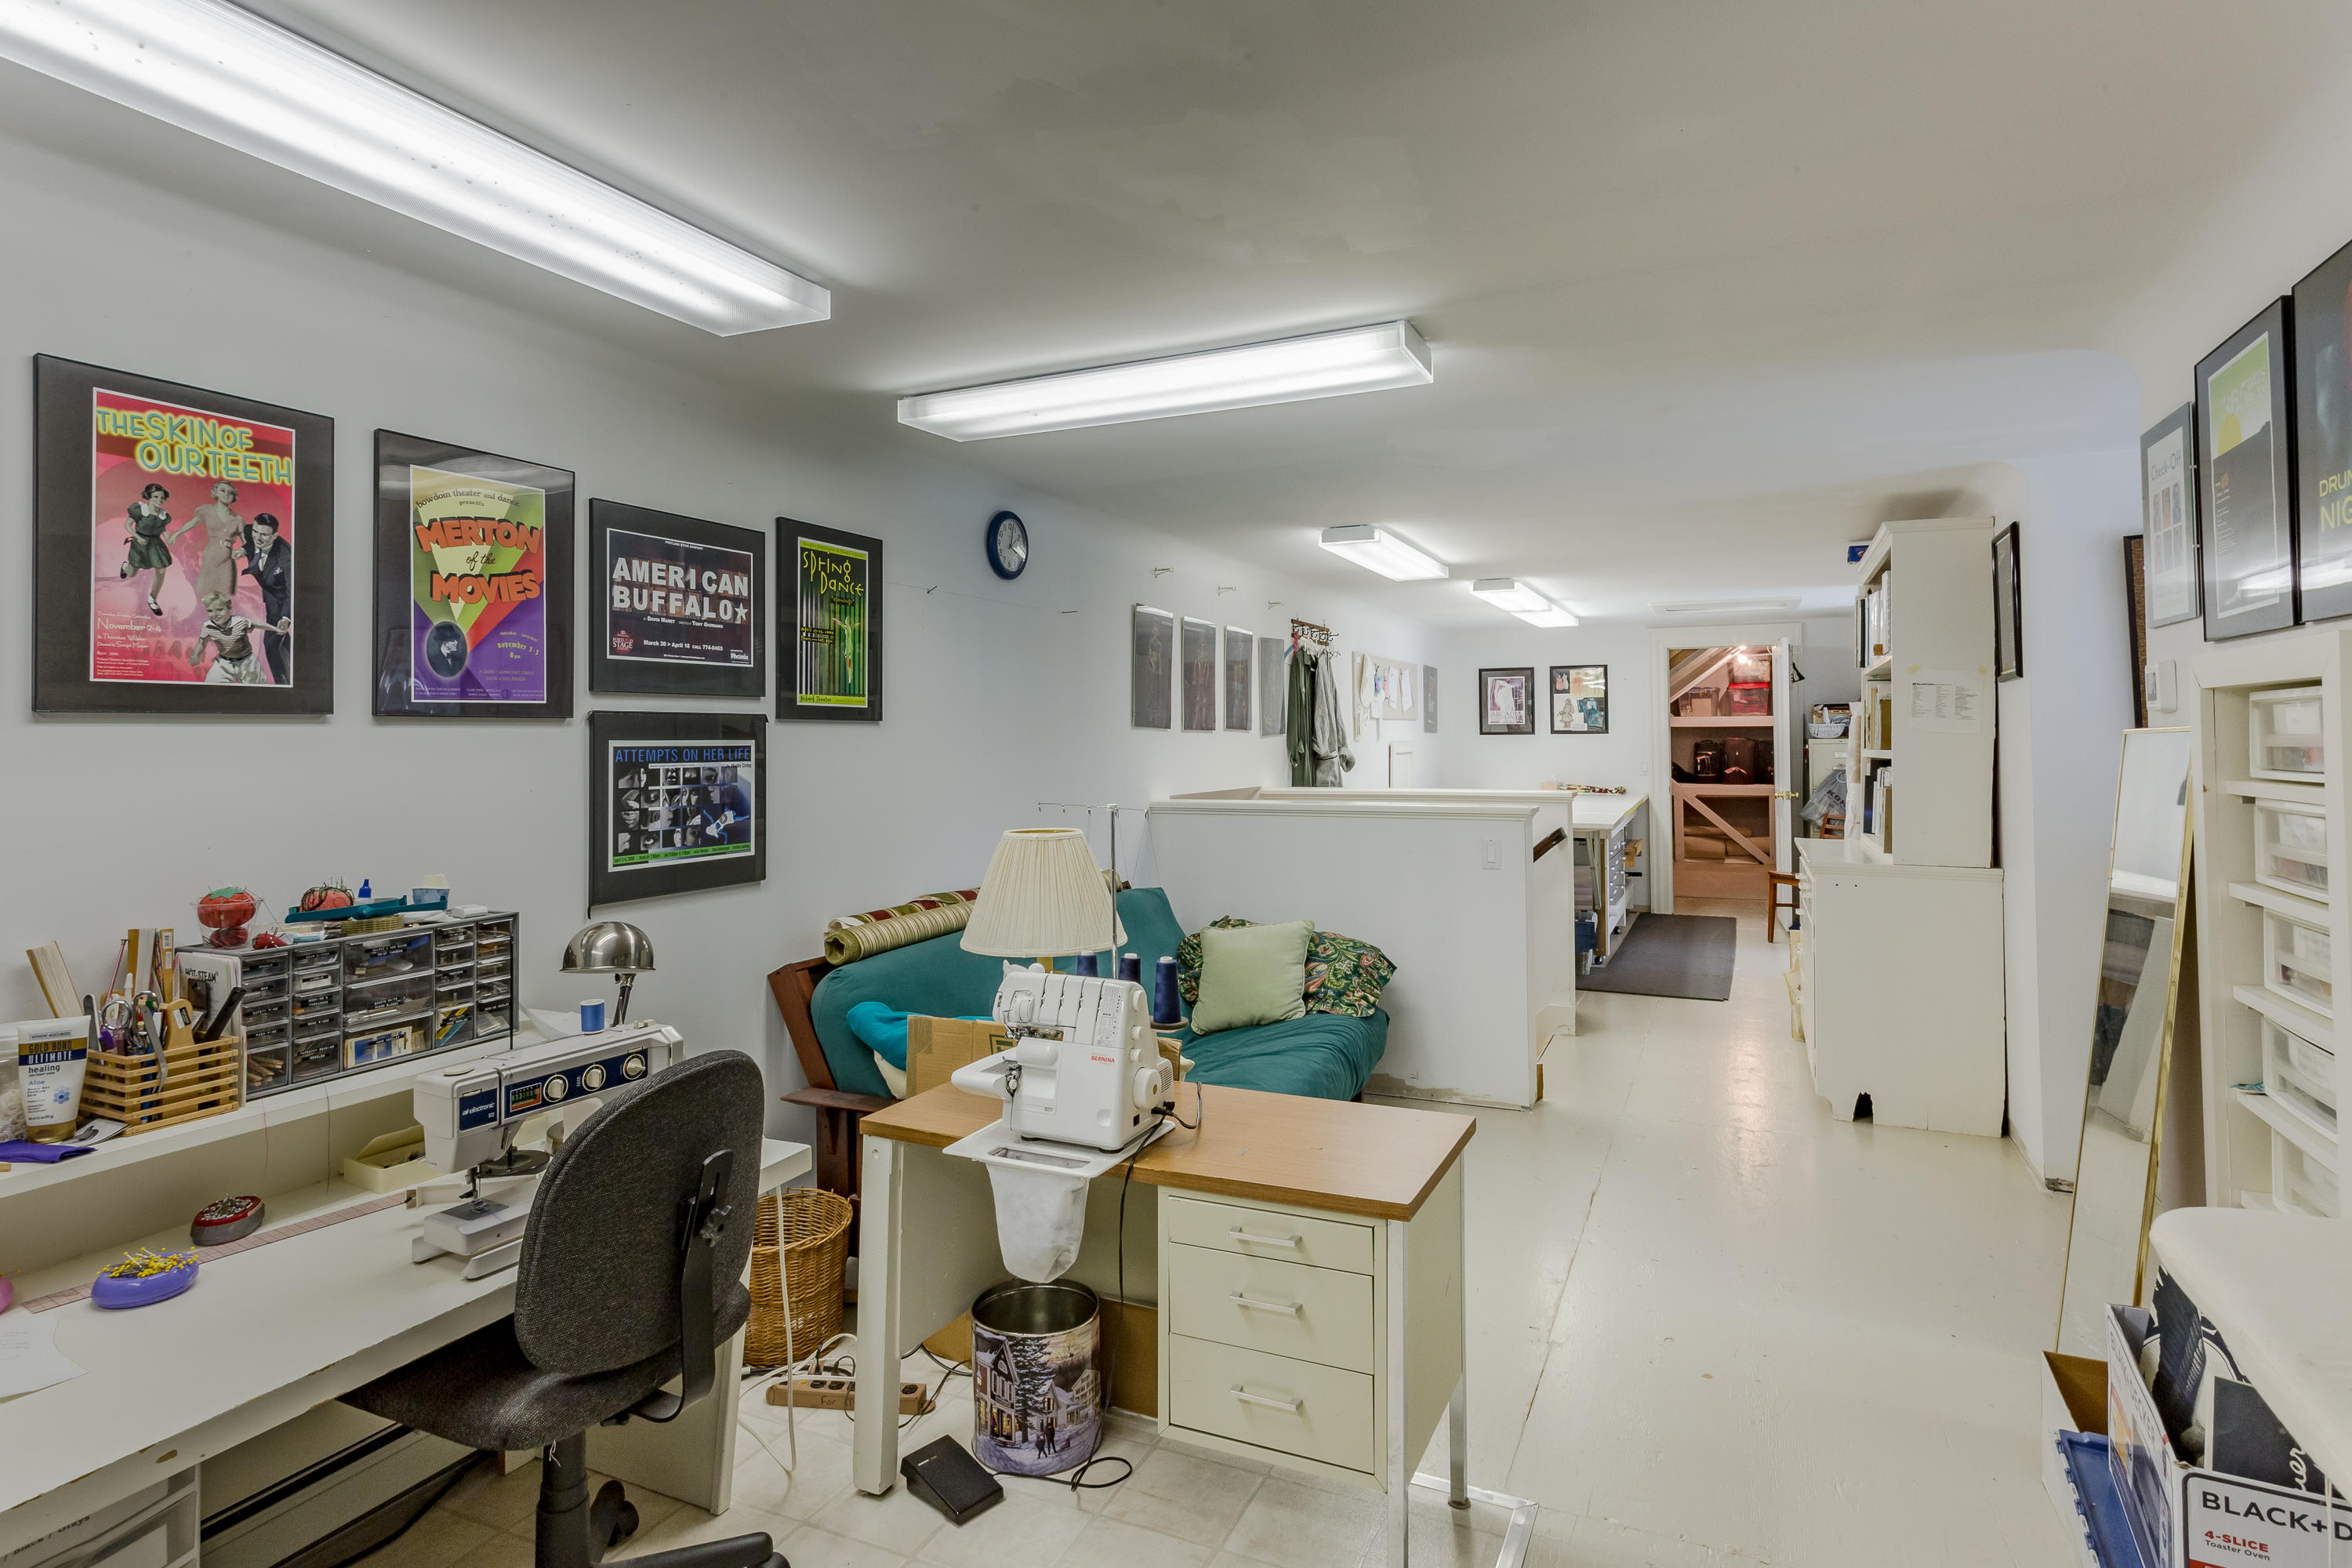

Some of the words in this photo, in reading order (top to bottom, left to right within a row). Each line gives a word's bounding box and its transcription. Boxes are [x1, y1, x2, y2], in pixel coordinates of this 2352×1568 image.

[96, 408, 145, 437] THE
[147, 412, 218, 448] SKIN
[220, 426, 252, 450] OF
[138, 441, 205, 476] OUR
[205, 449, 291, 485] TEETH
[416, 490, 451, 508] bowdoin
[498, 494, 520, 506] dance
[415, 517, 542, 554] MERTON
[466, 551, 479, 572] of
[481, 552, 496, 564] the
[430, 571, 541, 604] MOVIES
[612, 557, 749, 597] AMERICAN
[613, 586, 733, 620] BUFFALO
[97, 618, 146, 630] November
[615, 748, 678, 763] ATTEMPTS
[683, 748, 699, 761] ON
[703, 748, 724, 760] HER
[728, 747, 750, 760] LIFE
[28, 1051, 73, 1065] ULTIMATE
[29, 1043, 49, 1054] GOLD
[52, 1040, 73, 1051] BOND
[28, 1065, 60, 1074] healing
[2201, 1490, 2352, 1541] BLACK+D
[2205, 1530, 2270, 1553] 4-SLICE
[2205, 1539, 2241, 1554] Toaster
[2244, 1549, 2270, 1561] Oven
